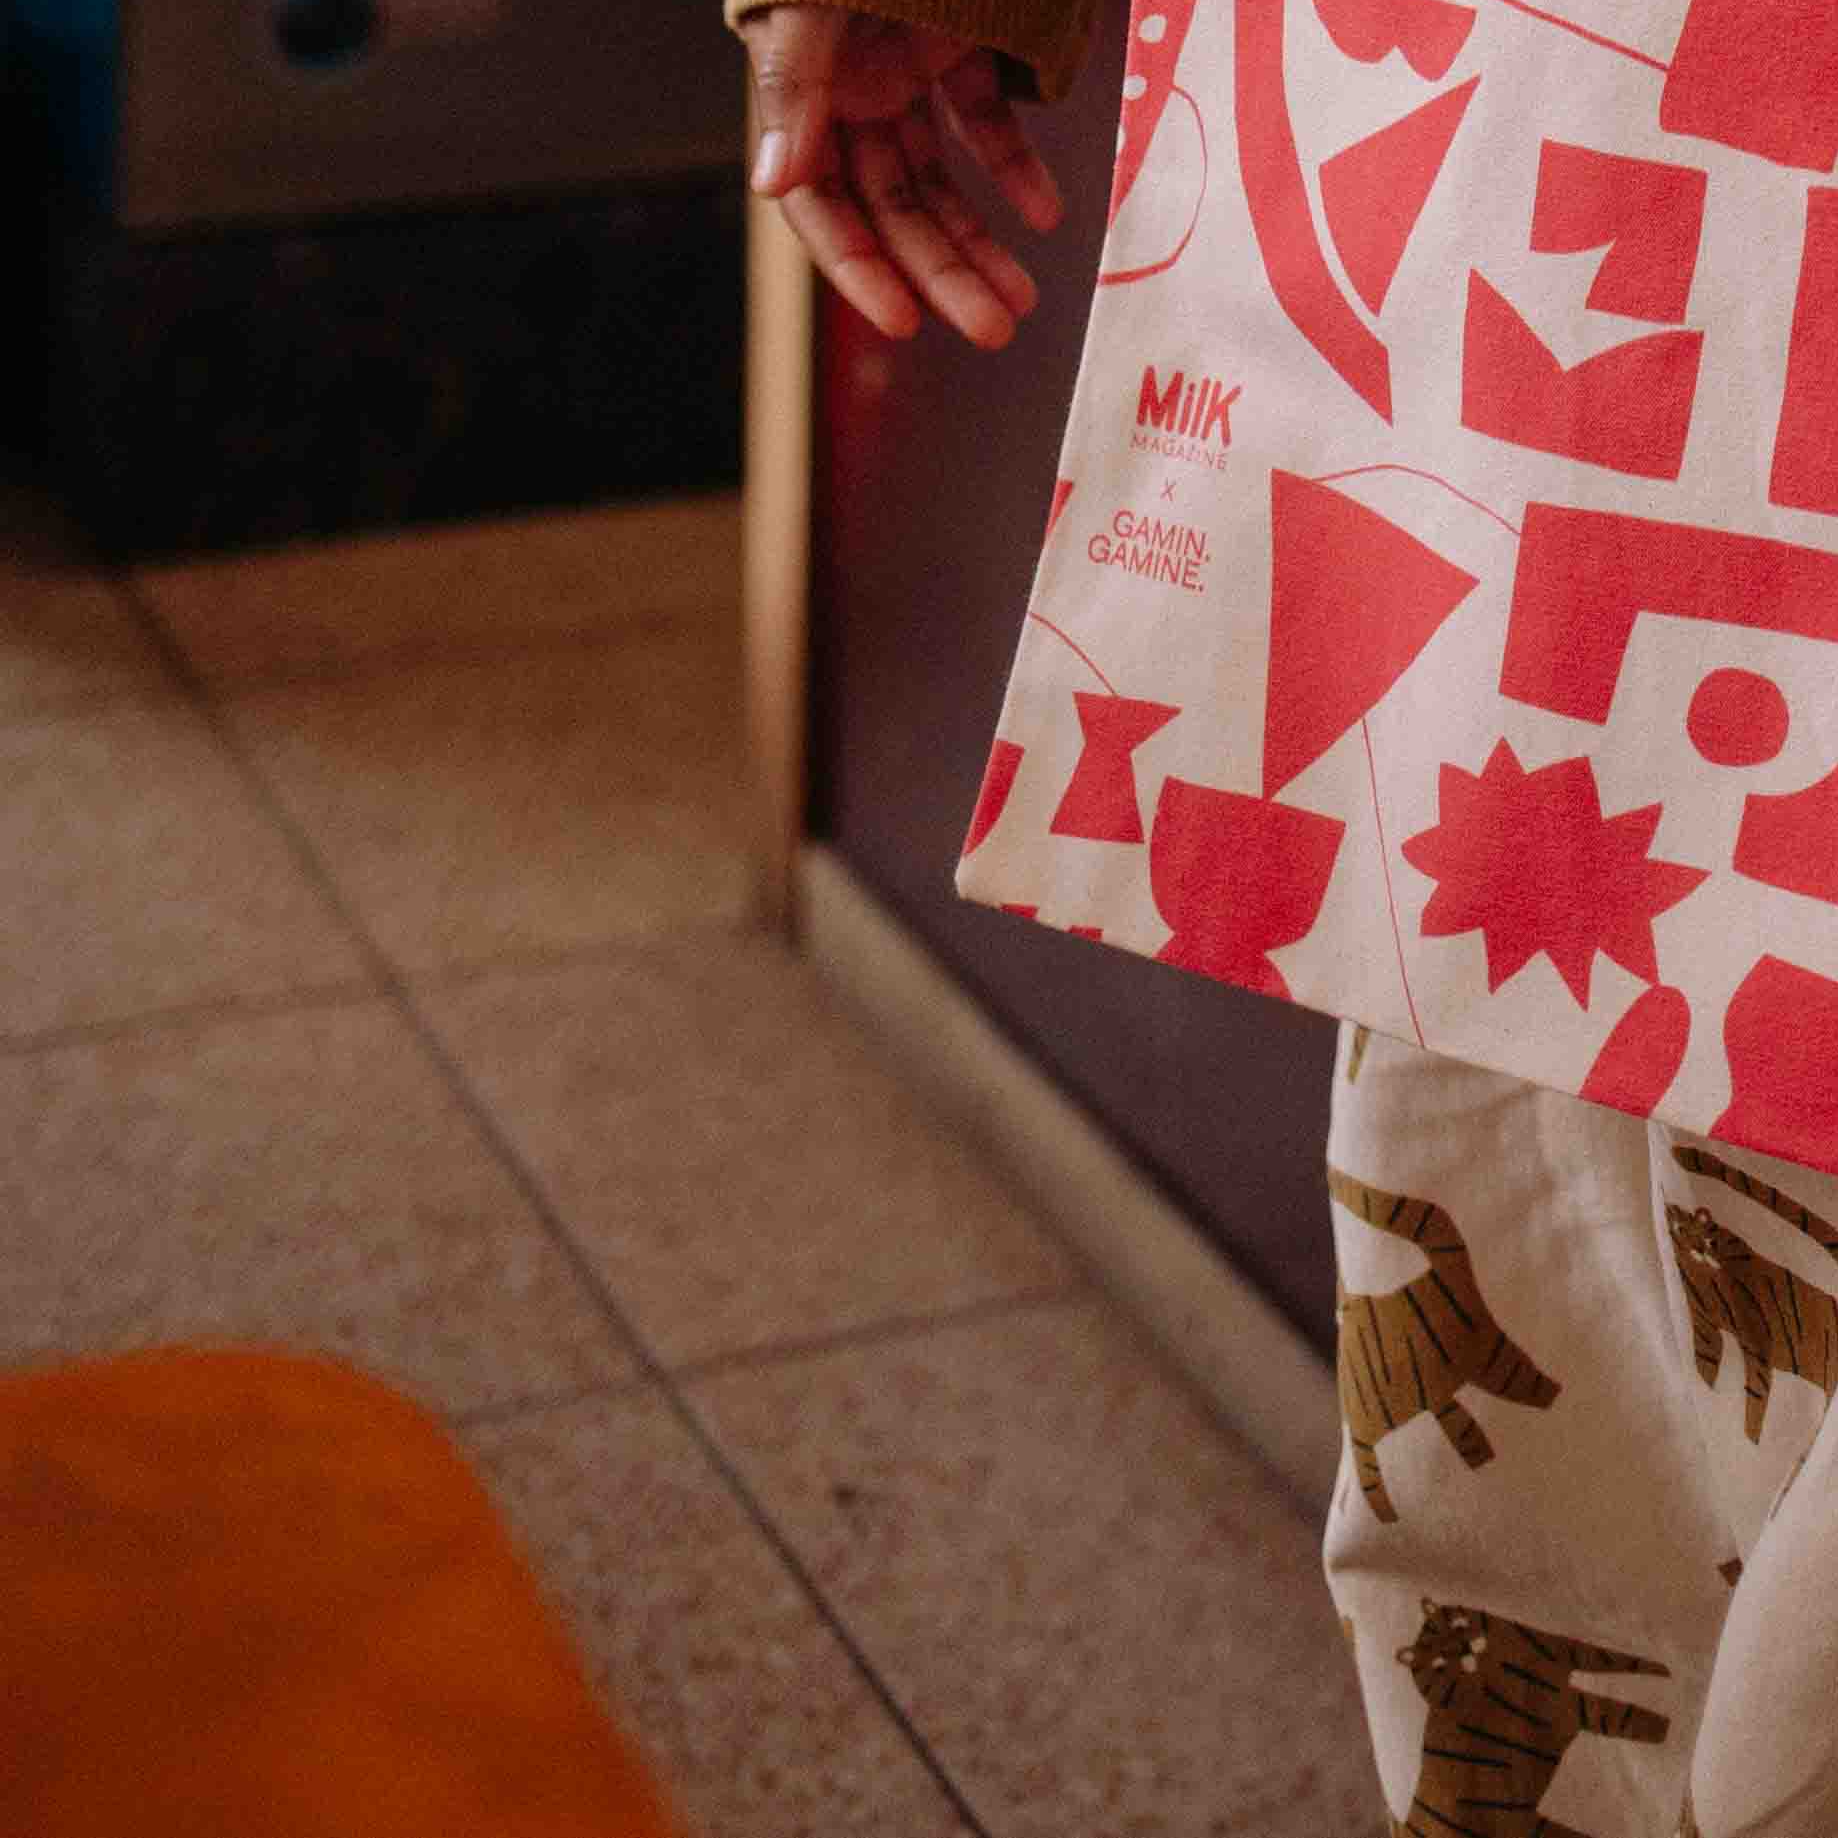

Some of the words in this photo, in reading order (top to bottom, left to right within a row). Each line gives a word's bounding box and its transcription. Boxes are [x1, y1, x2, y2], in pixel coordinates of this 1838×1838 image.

[1129, 430, 1228, 471] MAGAZINE
[1087, 533, 1205, 593] GAMINE.
[1112, 510, 1211, 563] GAMIN.
